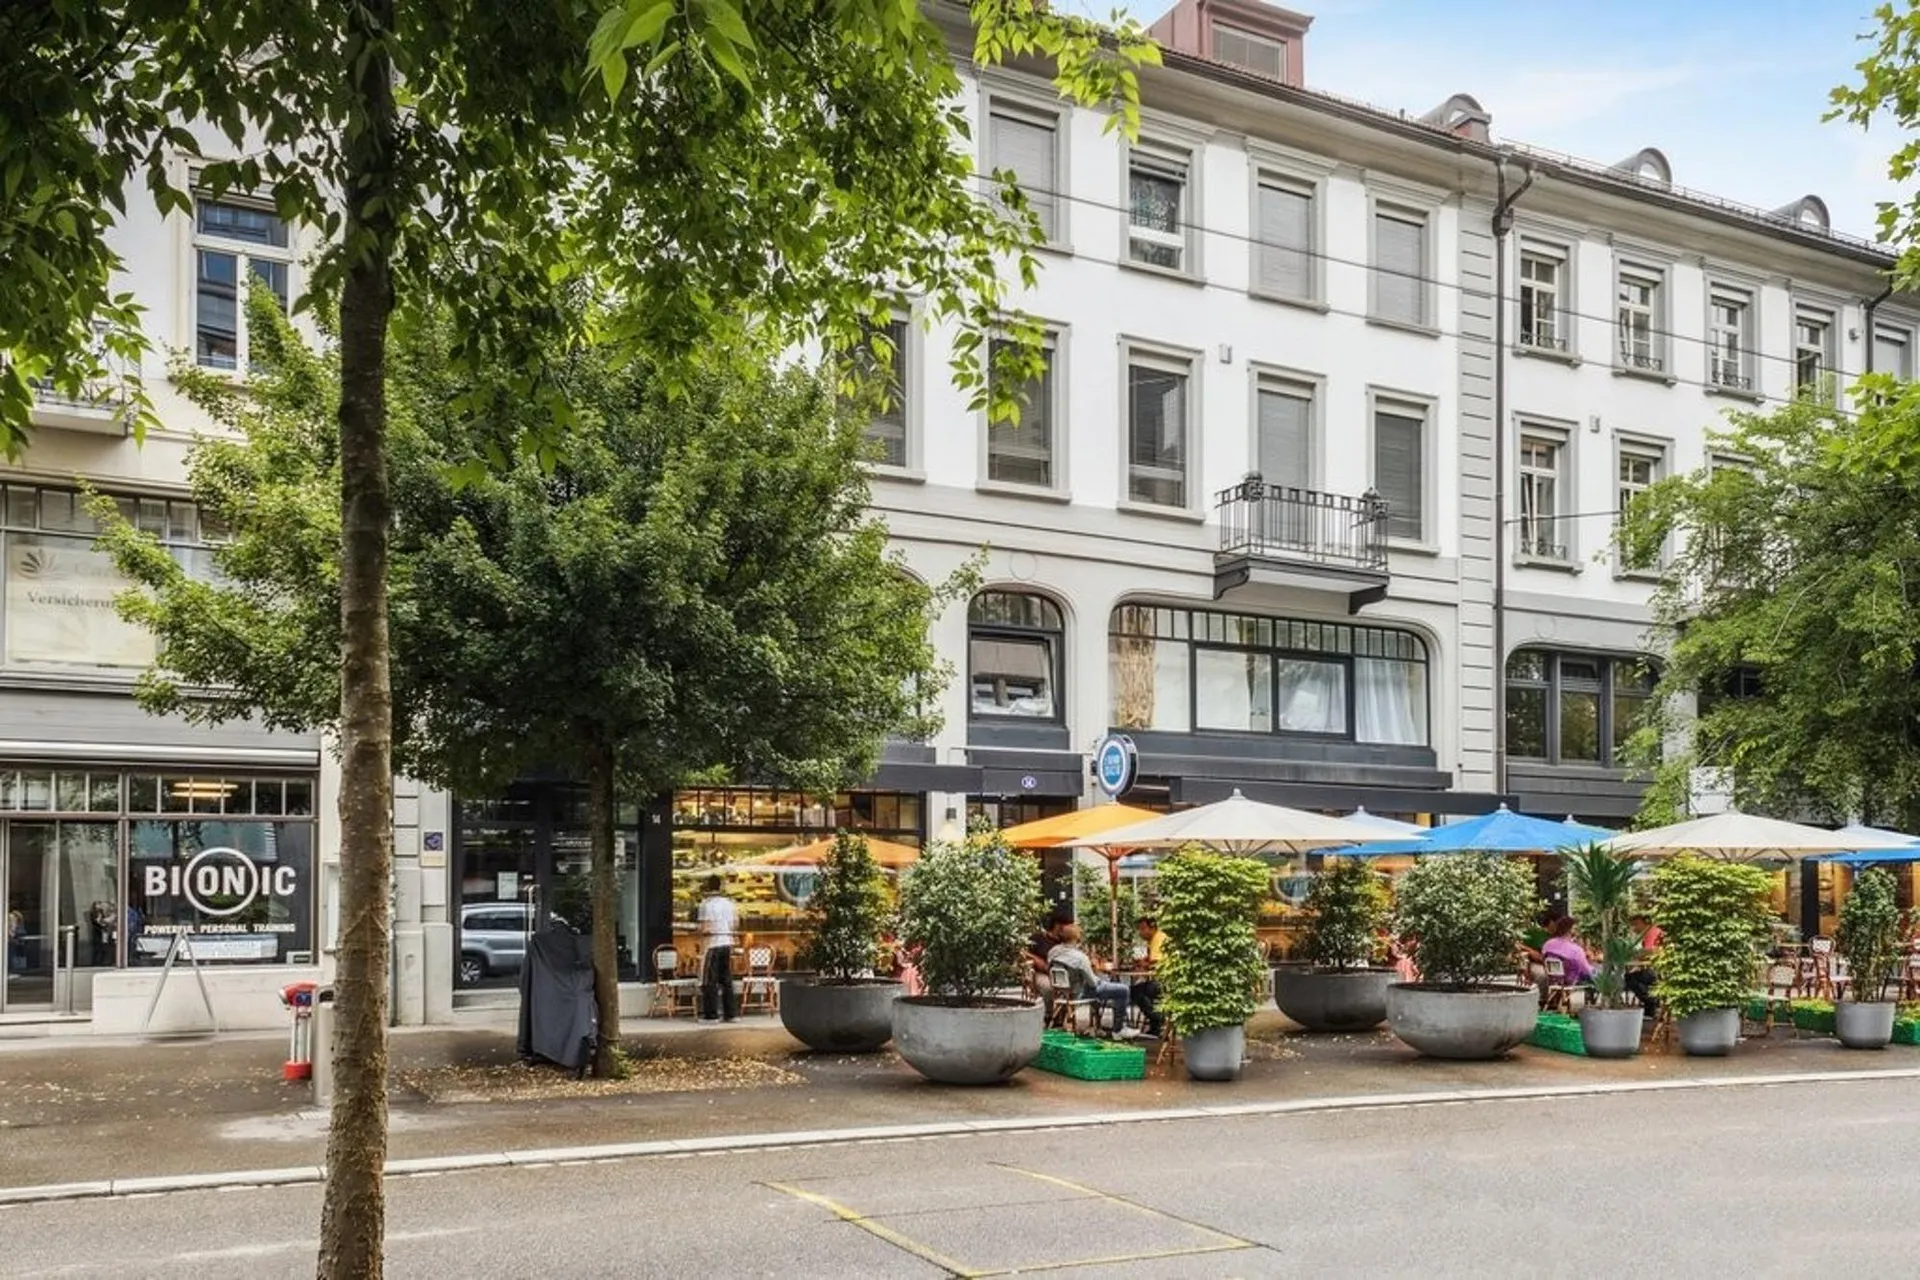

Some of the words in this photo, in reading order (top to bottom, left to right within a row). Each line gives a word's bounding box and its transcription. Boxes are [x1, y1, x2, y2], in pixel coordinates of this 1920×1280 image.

[144, 865, 297, 896] BIONIC
[144, 924, 195, 935] POWERFUL
[200, 923, 248, 934] PERSONAL
[253, 923, 296, 933] TRAINING
